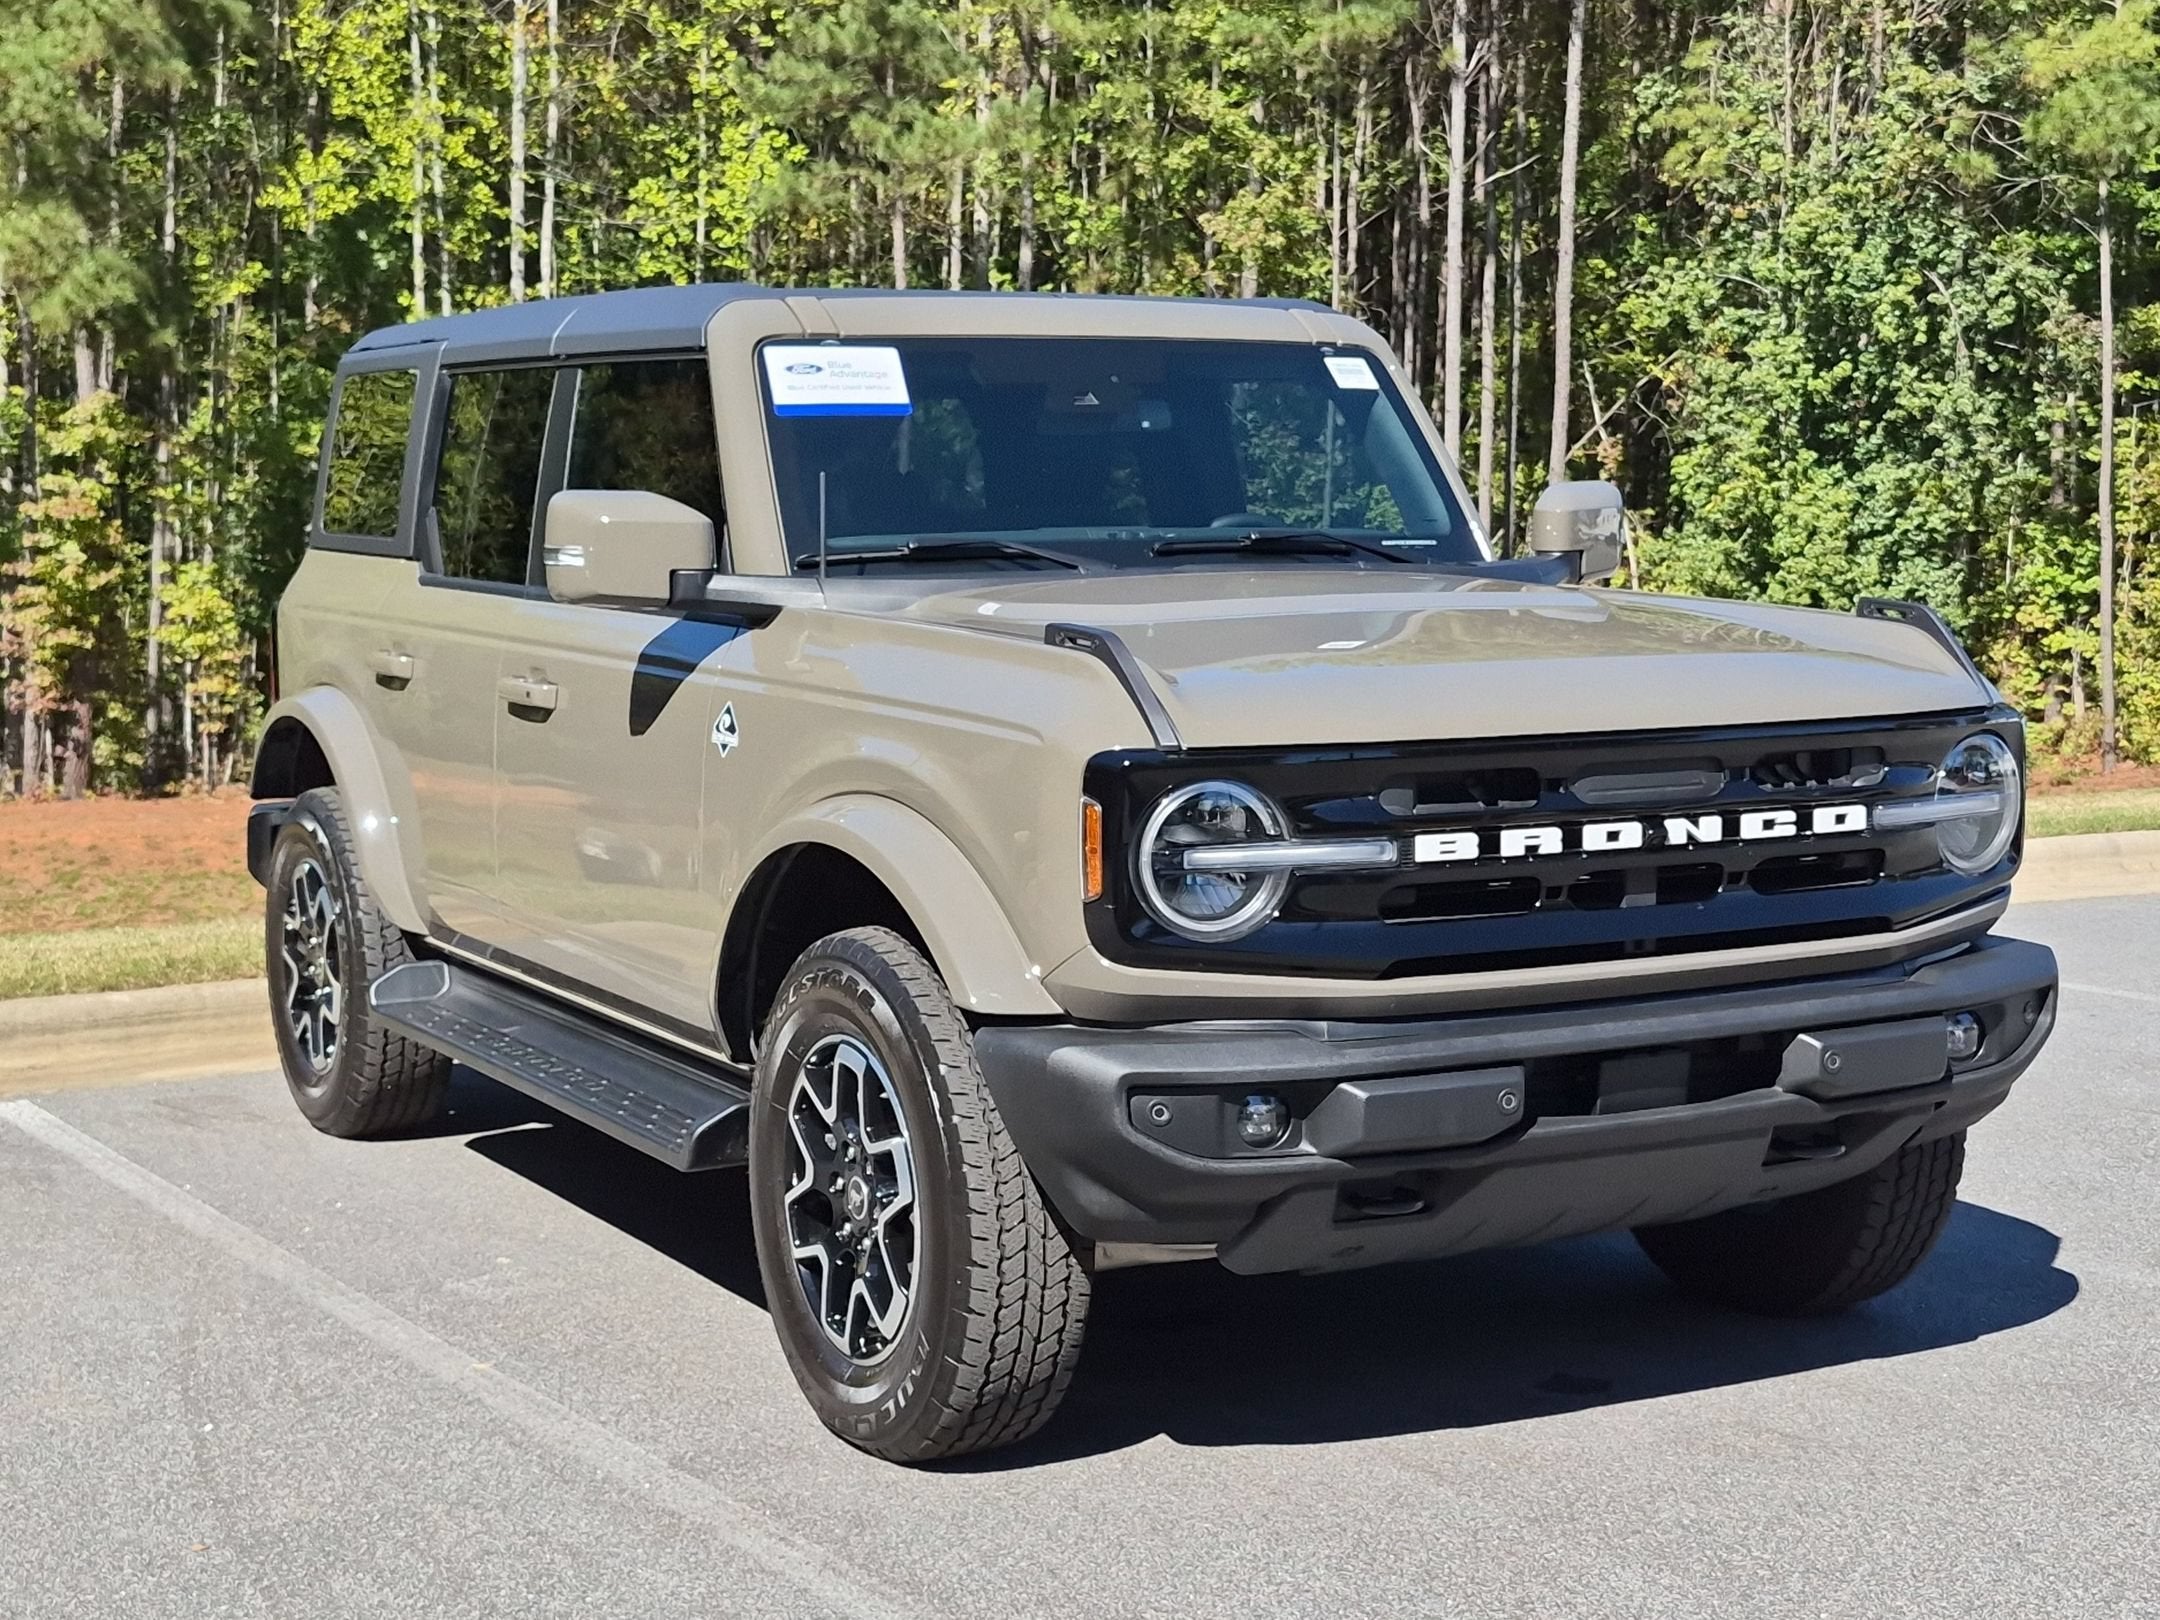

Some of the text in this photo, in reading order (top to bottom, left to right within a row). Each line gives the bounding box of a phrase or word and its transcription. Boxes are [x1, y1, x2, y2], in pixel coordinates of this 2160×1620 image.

[827, 361, 852, 369] Blue
[830, 370, 888, 379] Advantage
[1414, 804, 1867, 863] BRONCO
